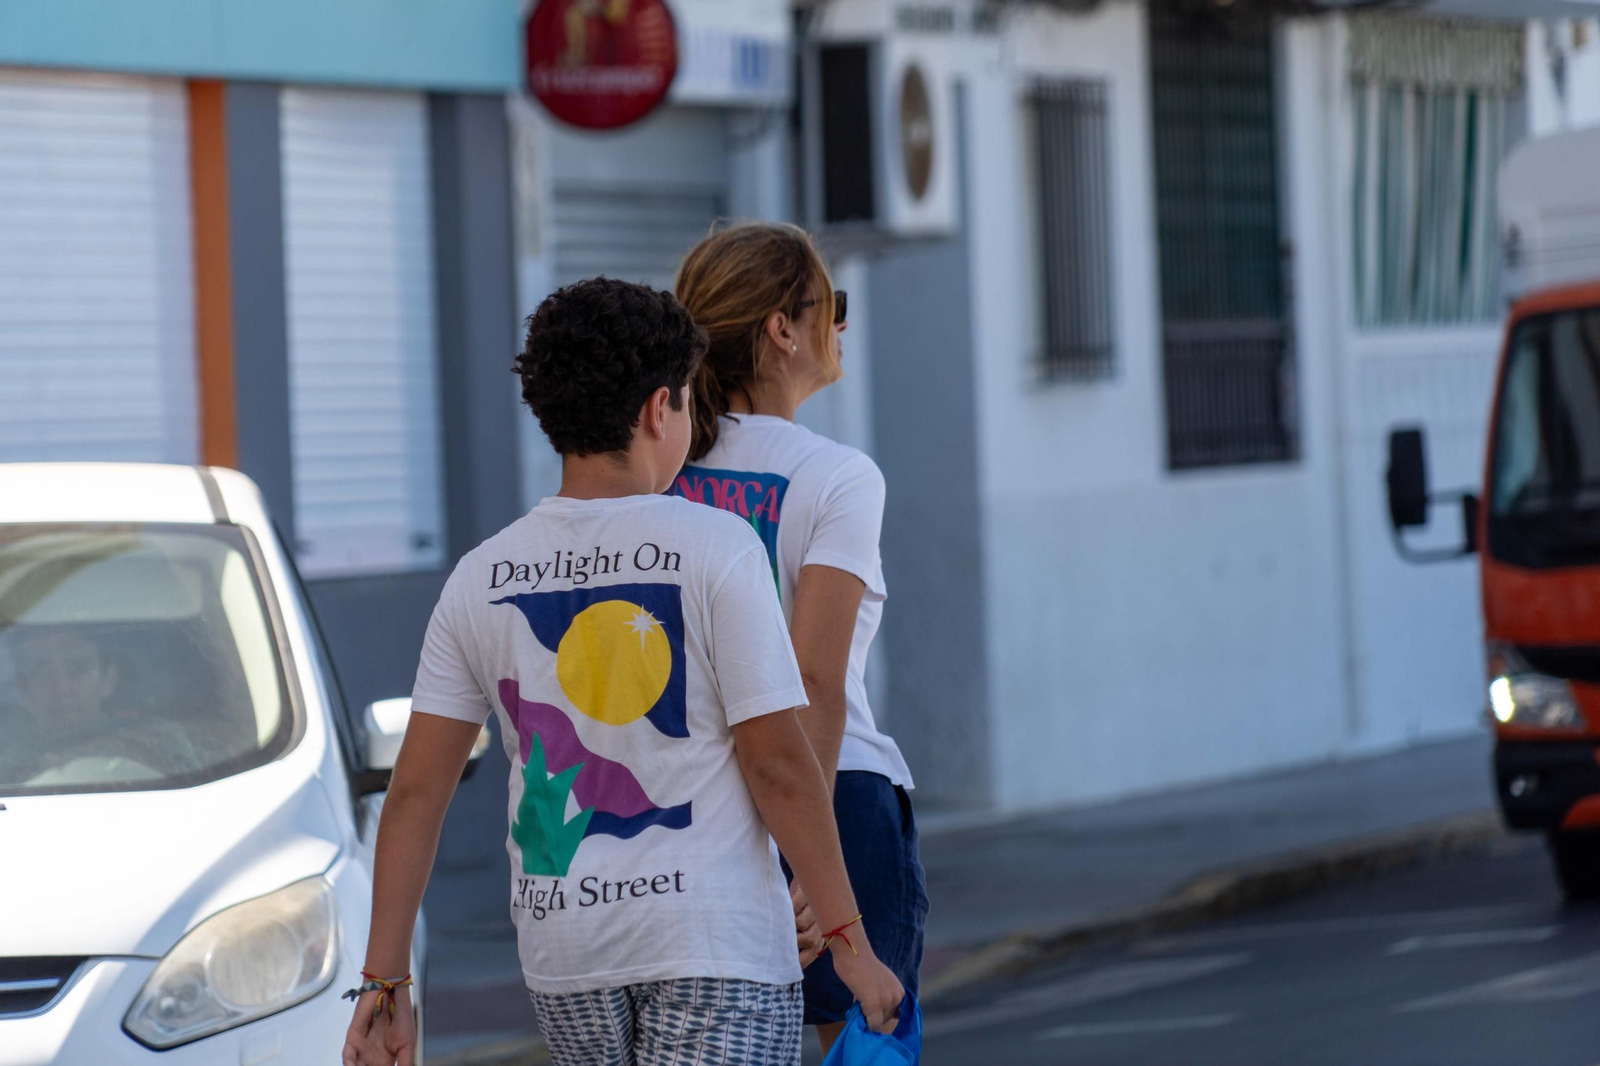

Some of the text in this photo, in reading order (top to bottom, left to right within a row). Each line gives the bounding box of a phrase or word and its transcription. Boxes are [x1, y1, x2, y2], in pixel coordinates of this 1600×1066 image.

[667, 474, 778, 523] NORCA
[488, 542, 681, 590] Daylight On
[513, 869, 686, 920] High Street
